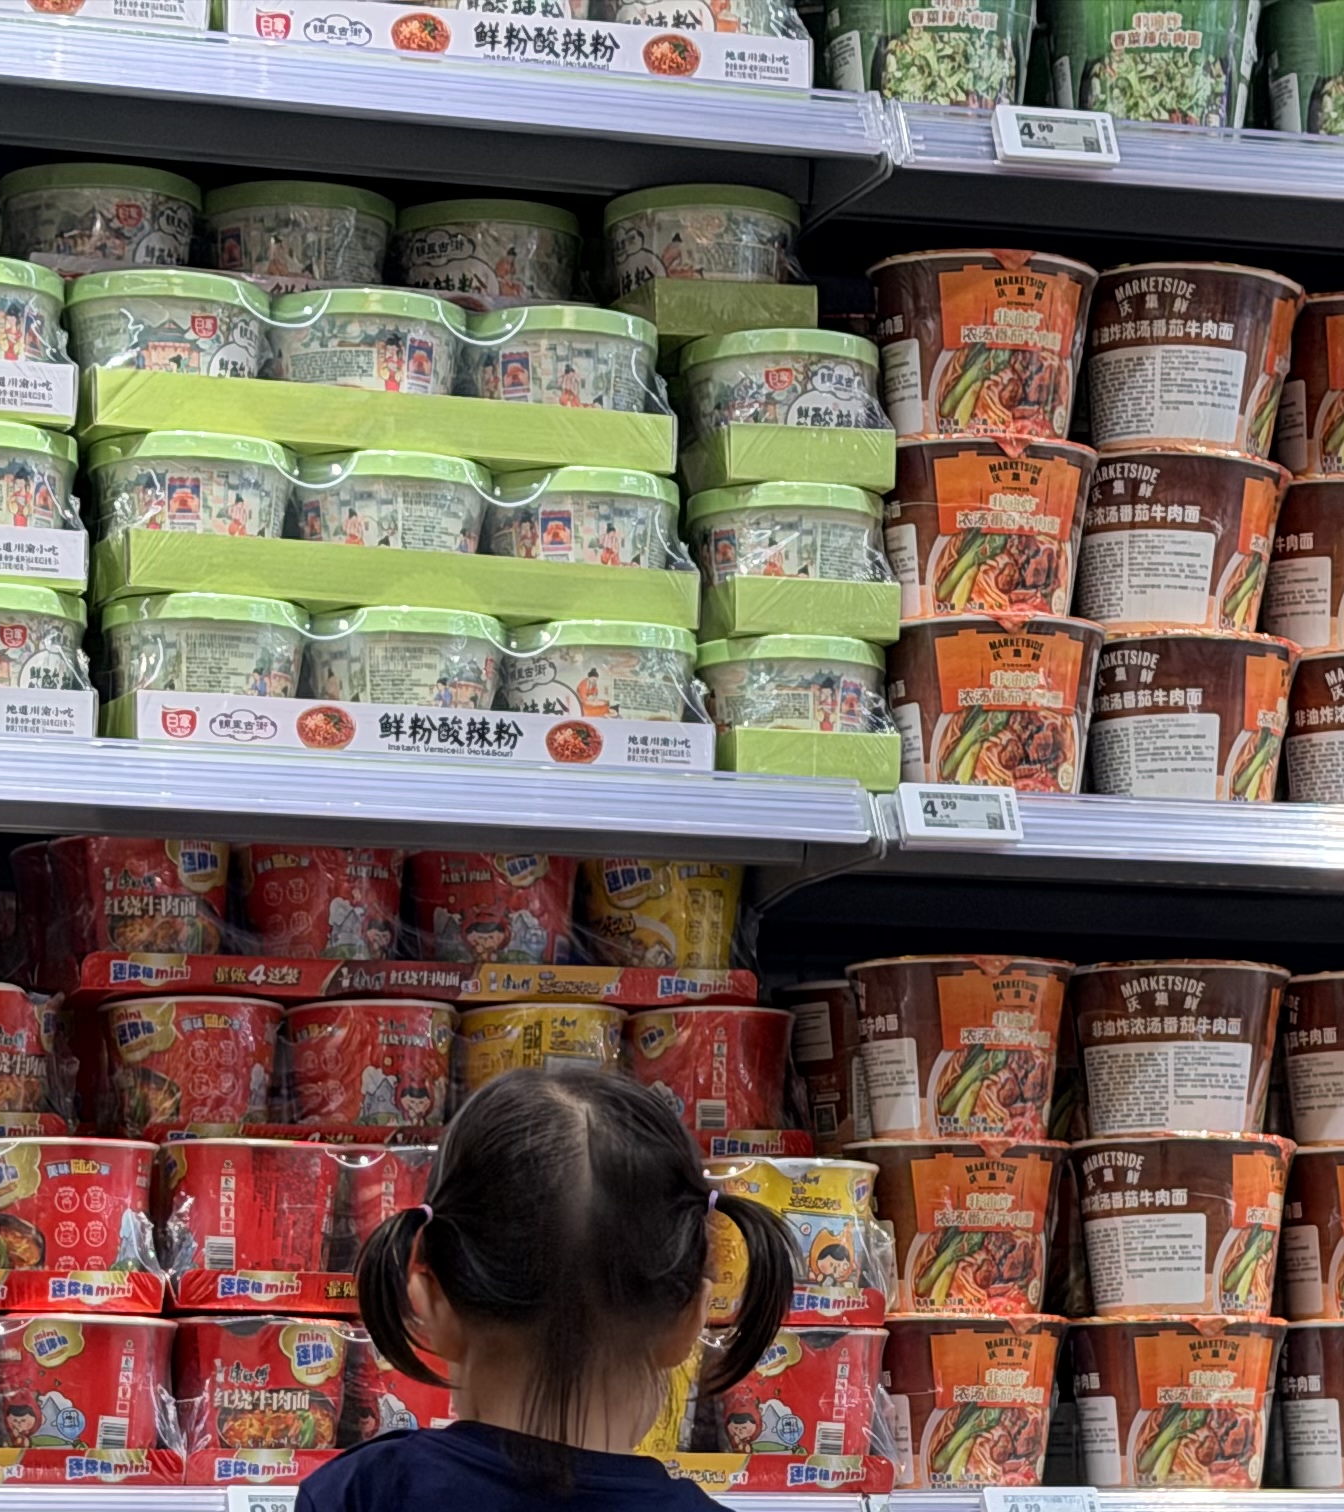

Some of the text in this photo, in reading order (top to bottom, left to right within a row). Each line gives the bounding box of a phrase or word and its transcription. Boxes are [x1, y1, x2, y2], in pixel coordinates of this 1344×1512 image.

[473, 23, 620, 63] 鲜粉酸辣粉
[1019, 122, 1054, 140] 4 99
[994, 275, 1047, 291] MARKETSIDE
[1114, 276, 1197, 302] MARKETSIDE
[988, 460, 1043, 478] MARKETSIDE
[989, 638, 1044, 652] MARKETSIDE
[378, 711, 524, 751] 鲜粉酸辣粉
[922, 800, 957, 818] 4 99
[104, 896, 197, 916] 红烧牛肉面
[389, 970, 461, 987] 红烧牛肉面
[1119, 974, 1208, 1000] MARKETSIDE
[1092, 1016, 1242, 1037] 非油炸浓汤番茄牛肉面
[214, 1388, 310, 1410] 红烧牛肉面
